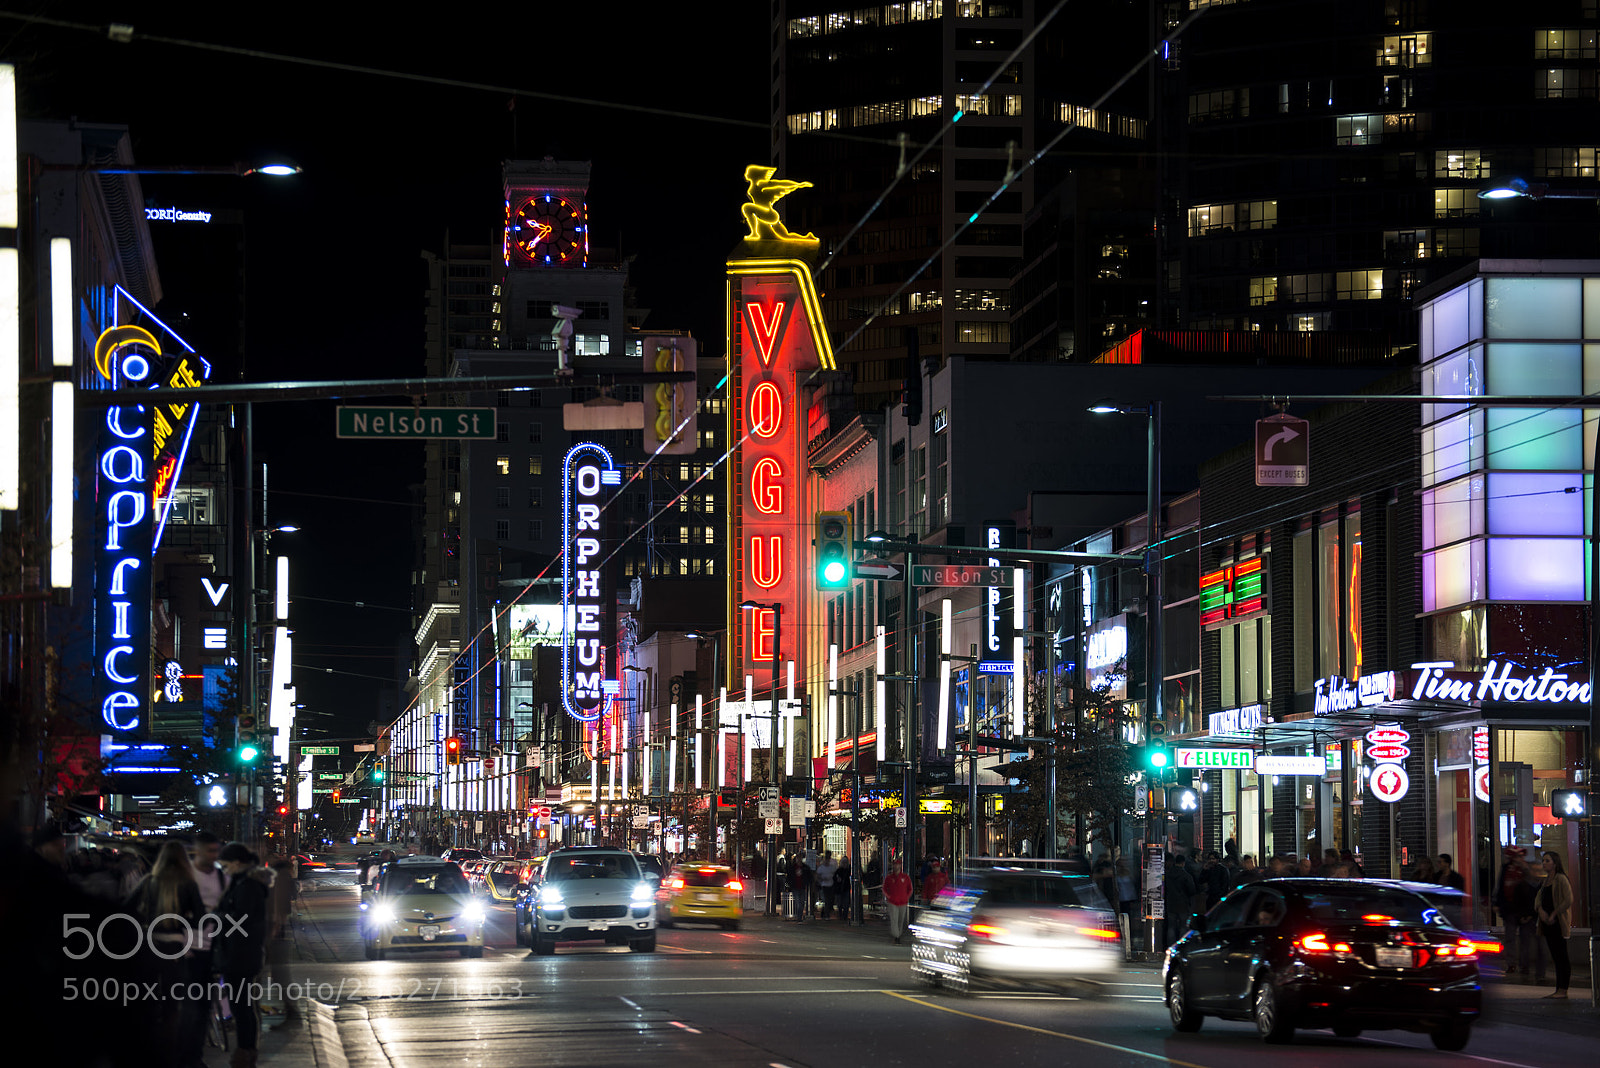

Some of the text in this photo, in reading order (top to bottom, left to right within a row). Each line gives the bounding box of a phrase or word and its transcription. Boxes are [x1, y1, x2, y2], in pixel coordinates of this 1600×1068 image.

[353, 412, 481, 434] Nelson St
[746, 302, 786, 662] VOGUE
[1259, 470, 1305, 479] EXCEPT BUSES
[576, 465, 601, 699] ORPHEUM
[921, 569, 1006, 584] Nelson St
[979, 664, 1014, 673] NIGHTCLU
[1411, 659, 1591, 704] Tim Horton
[1314, 678, 1329, 716] Tim
[1328, 674, 1357, 713] Hortons
[1208, 704, 1262, 738] HUNGRY GUYS
[1389, 748, 1405, 756] 1964
